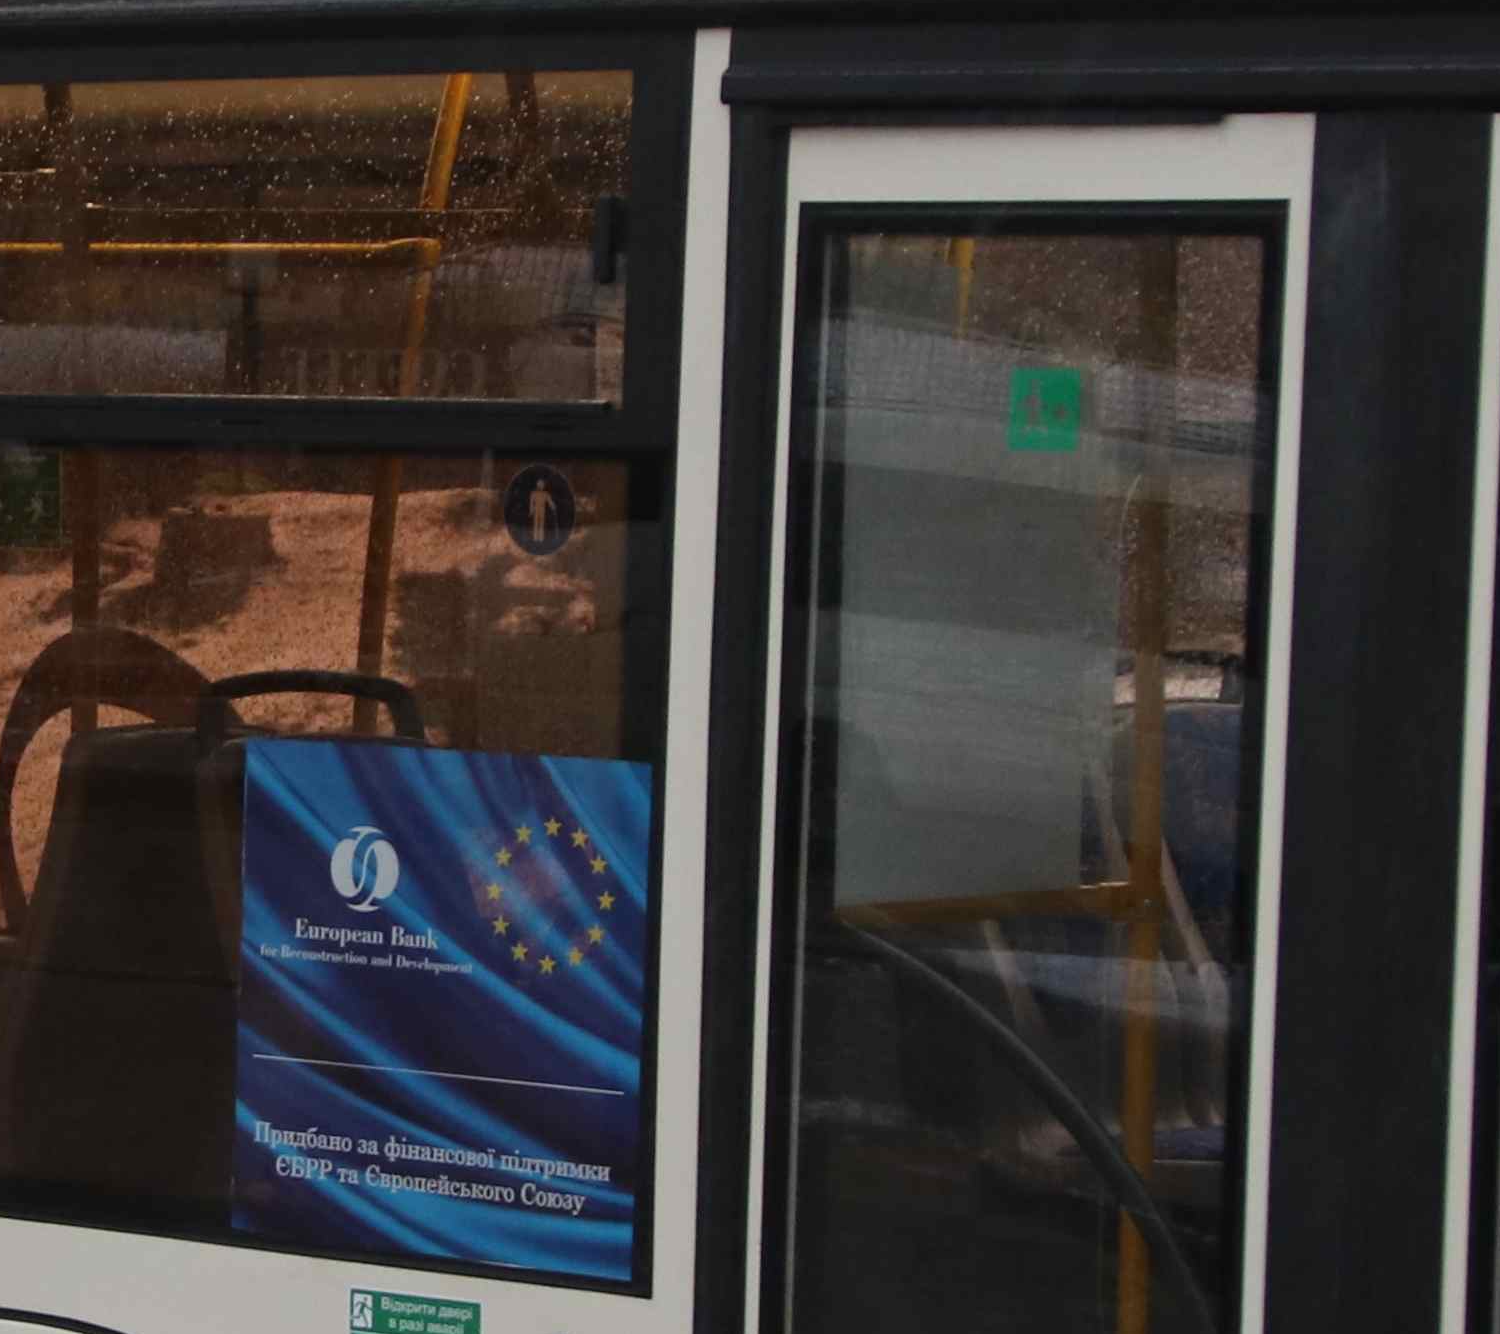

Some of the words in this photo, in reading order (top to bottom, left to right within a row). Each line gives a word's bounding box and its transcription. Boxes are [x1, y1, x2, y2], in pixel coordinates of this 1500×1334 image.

[295, 917, 384, 947] European
[391, 925, 440, 950] Bank
[260, 943, 278, 957] for
[281, 944, 368, 965] Reconstruction
[371, 953, 392, 967] and
[396, 954, 473, 975] Development
[254, 1121, 352, 1153] Придбано
[357, 1139, 379, 1156] за
[384, 1135, 497, 1169] фінансової
[501, 1150, 612, 1182] підтримки
[275, 1155, 333, 1179] ЄБРР
[336, 1168, 360, 1186] та
[364, 1165, 515, 1203] Європейського
[520, 1183, 586, 1216] Союзу
[381, 1296, 436, 1316] Відкрити
[438, 1305, 473, 1320] двері
[388, 1318, 397, 1328] в
[400, 1319, 425, 1332] разі
